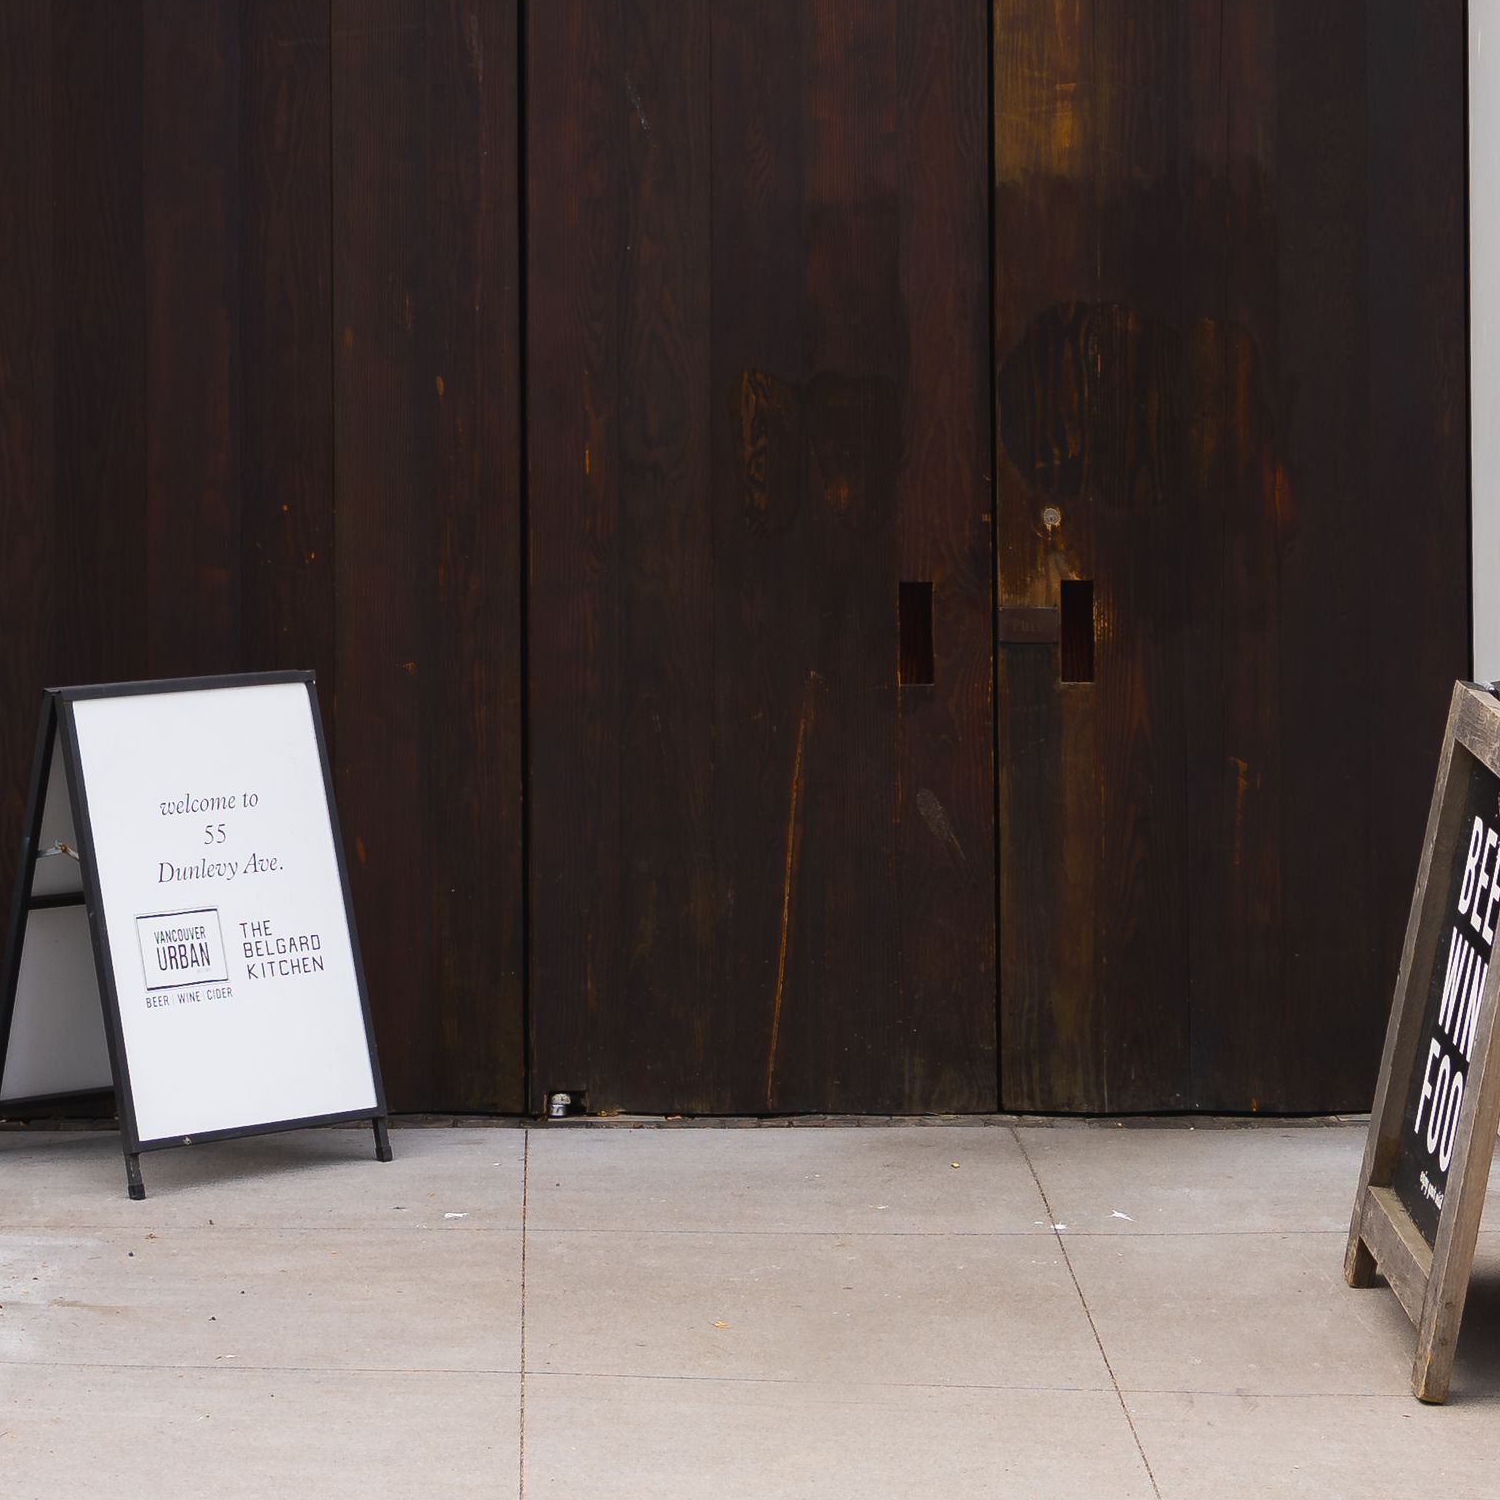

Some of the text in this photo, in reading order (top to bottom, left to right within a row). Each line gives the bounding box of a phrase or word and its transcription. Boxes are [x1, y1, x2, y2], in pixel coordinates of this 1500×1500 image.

[160, 792, 258, 815] welcome to
[205, 824, 225, 844] 55
[159, 853, 283, 883] Dunlevy Ave.
[154, 926, 205, 944] VANCOUVER
[239, 920, 272, 938] THE
[157, 942, 210, 970] URBAN
[243, 935, 320, 958] BELGARD
[247, 956, 323, 979] KITCHEN
[146, 987, 232, 1008] BEER WINE CIDER
